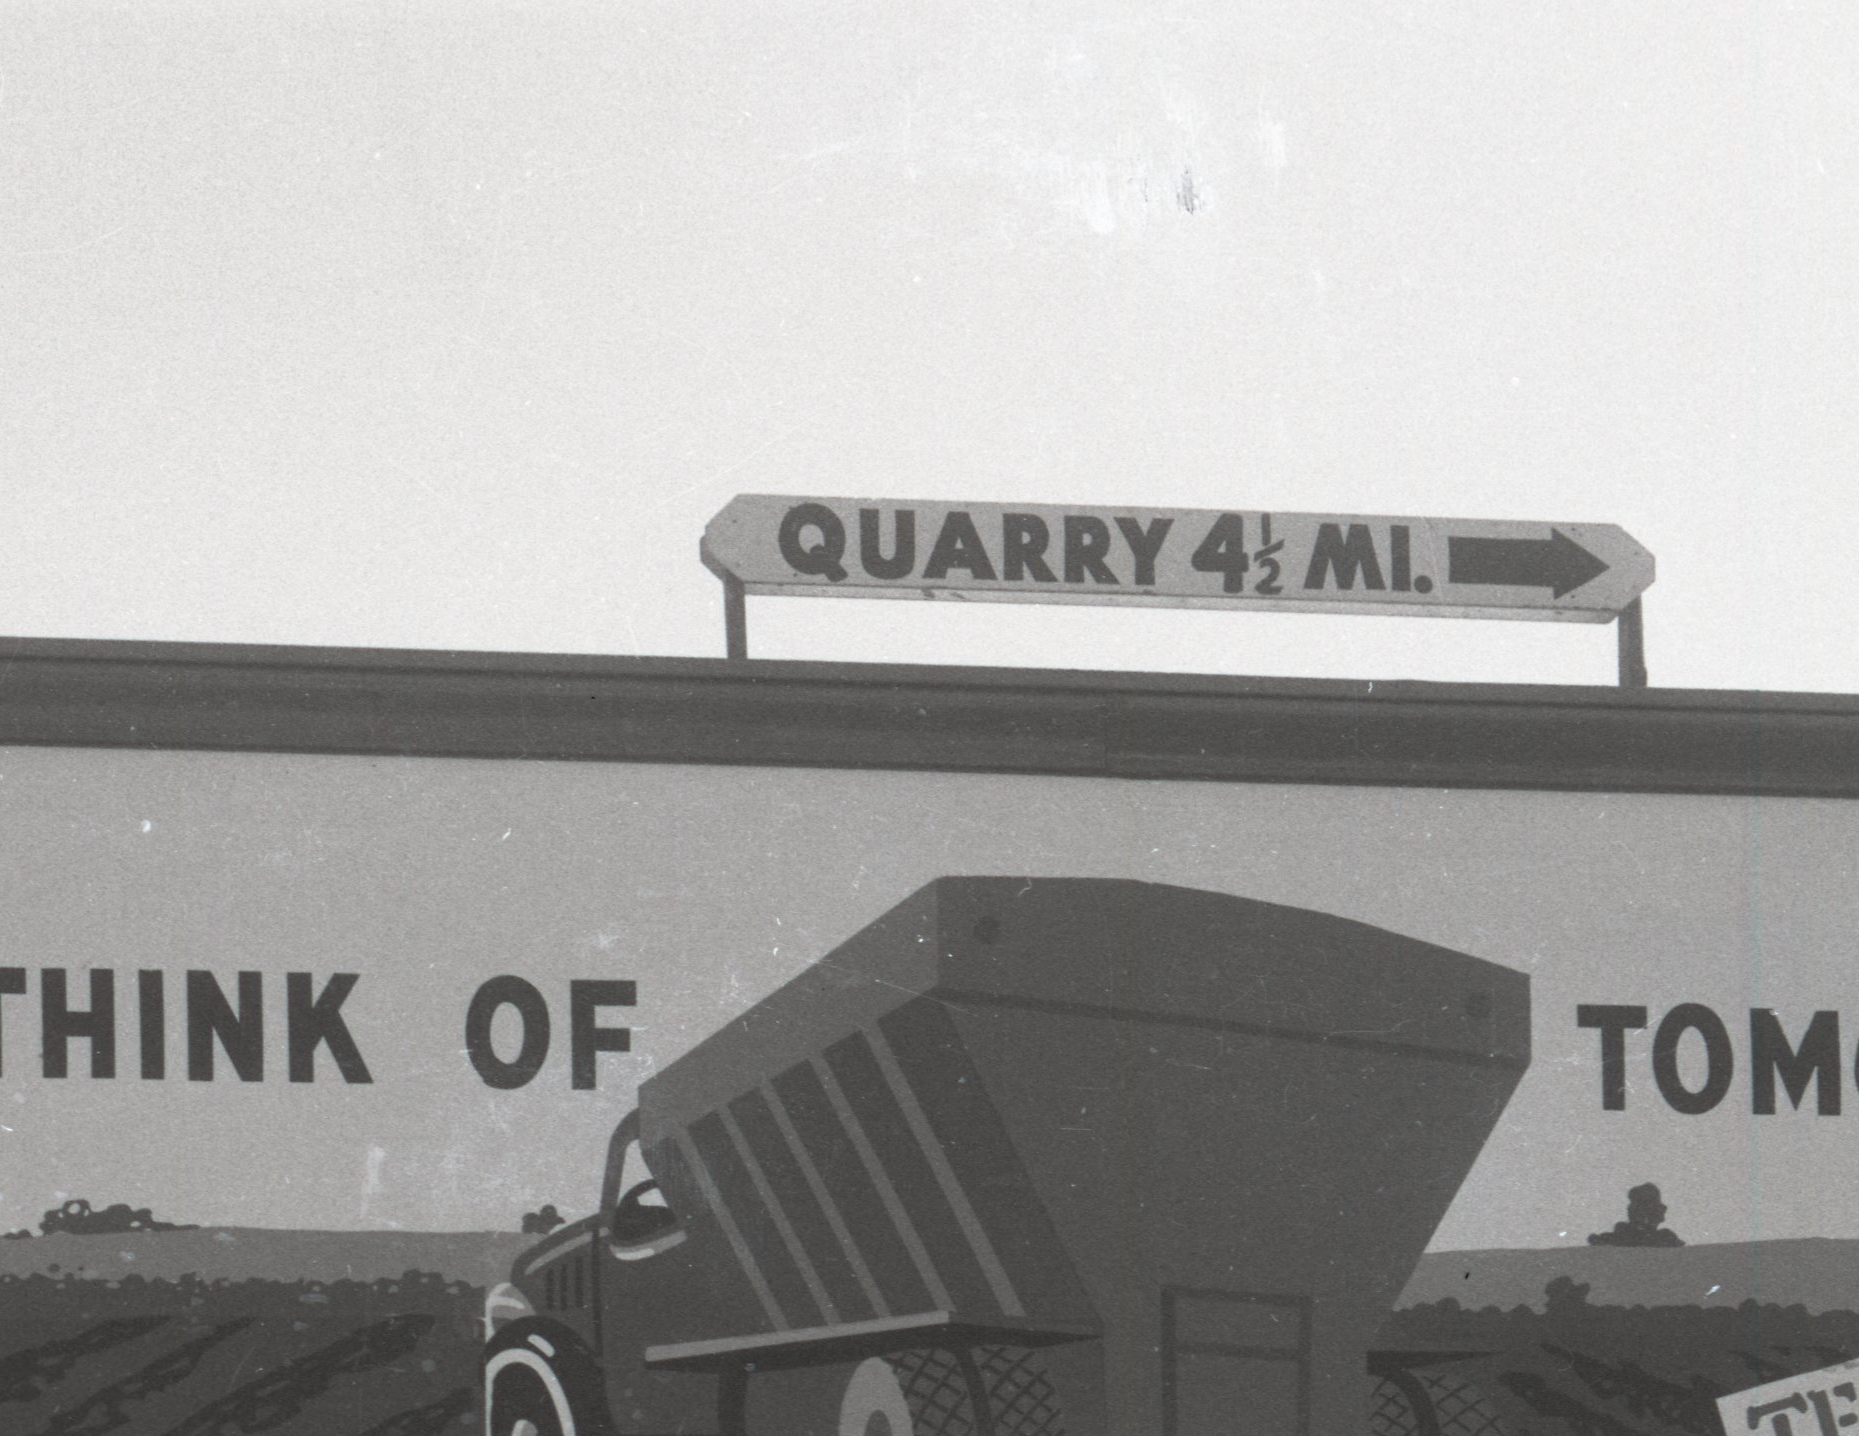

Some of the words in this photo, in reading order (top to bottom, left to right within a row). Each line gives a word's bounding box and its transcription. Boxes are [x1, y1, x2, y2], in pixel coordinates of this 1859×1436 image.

[777, 502, 1175, 586] QUARRY
[1302, 522, 1434, 595] MI.
[464, 974, 639, 1091] OF
